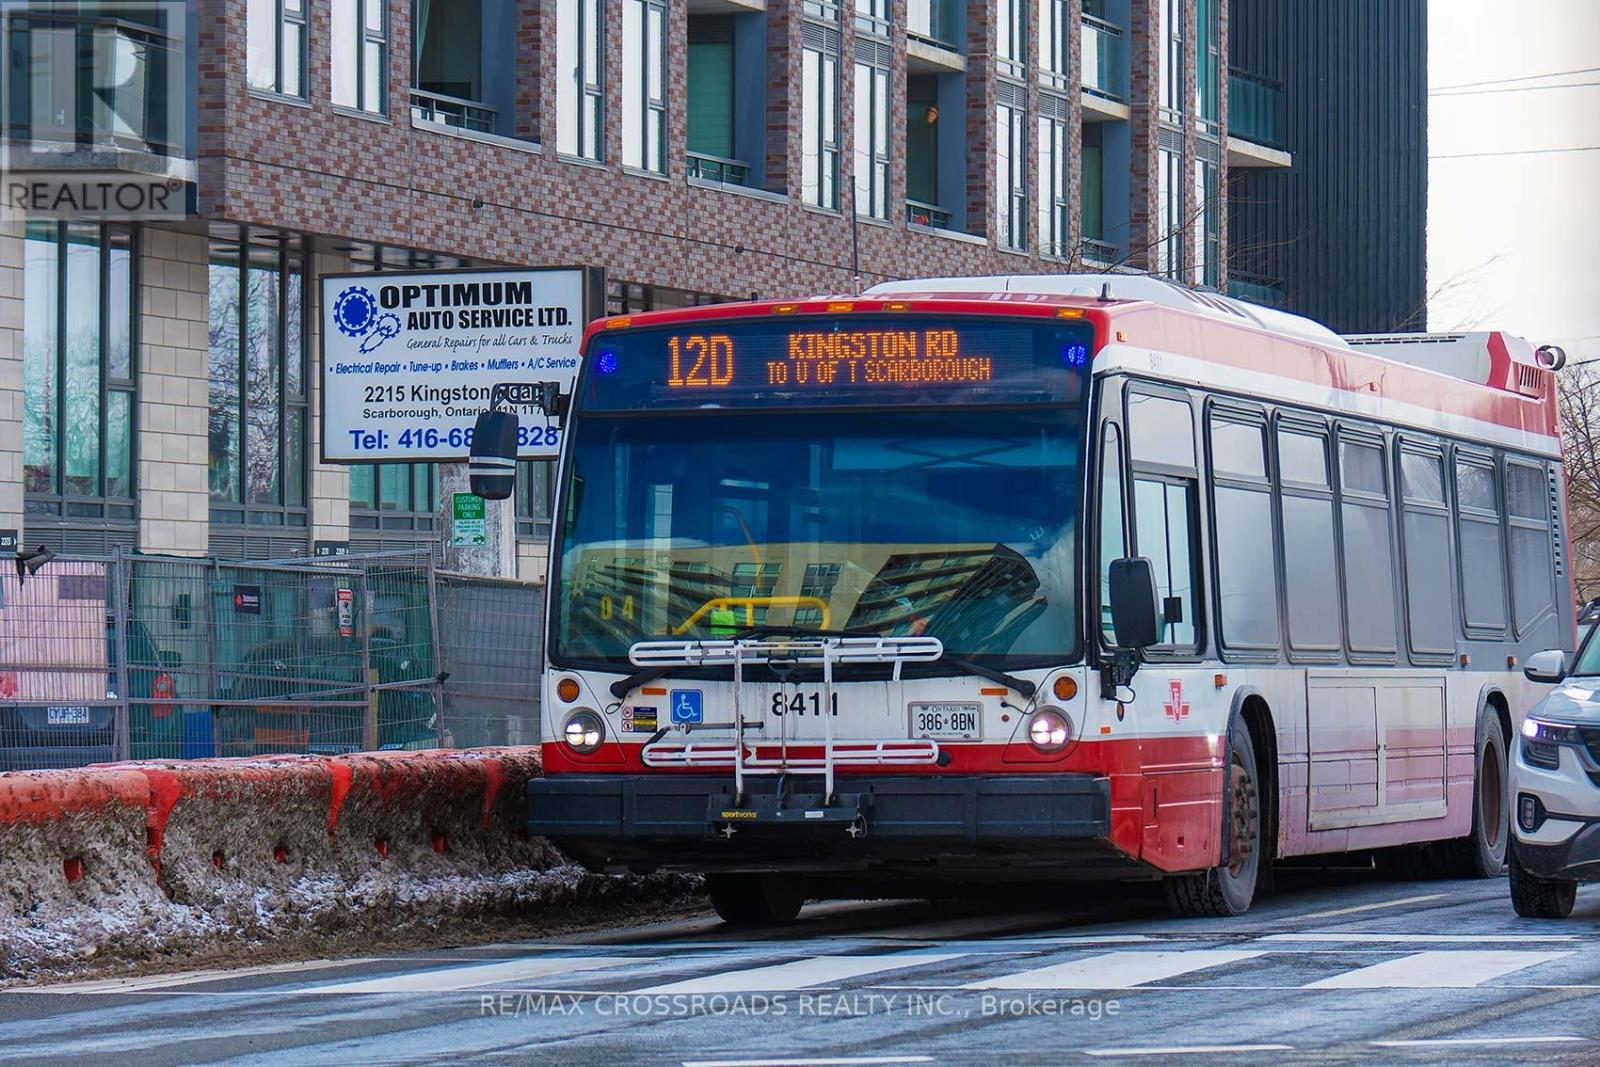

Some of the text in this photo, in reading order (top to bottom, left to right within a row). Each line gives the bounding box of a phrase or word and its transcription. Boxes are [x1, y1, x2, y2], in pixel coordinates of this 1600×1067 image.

[379, 281, 532, 309] OPTIMUM
[407, 306, 572, 330] AUTO SERVICE LTD.
[407, 332, 572, 353] General Repairs for all Cars & Trucks
[788, 330, 958, 359] KINGSTON RD
[335, 356, 577, 376] Electrical Repair Tune-up Brakes Mufflers A/C Service
[668, 335, 733, 386] 12D
[767, 357, 991, 384] TO U OF T SCARBOROUGH
[364, 386, 405, 403] 2215
[412, 384, 490, 406] Kingston
[363, 406, 441, 420] Scarborough,
[349, 429, 389, 450] Tel:
[771, 691, 838, 716] 8411
